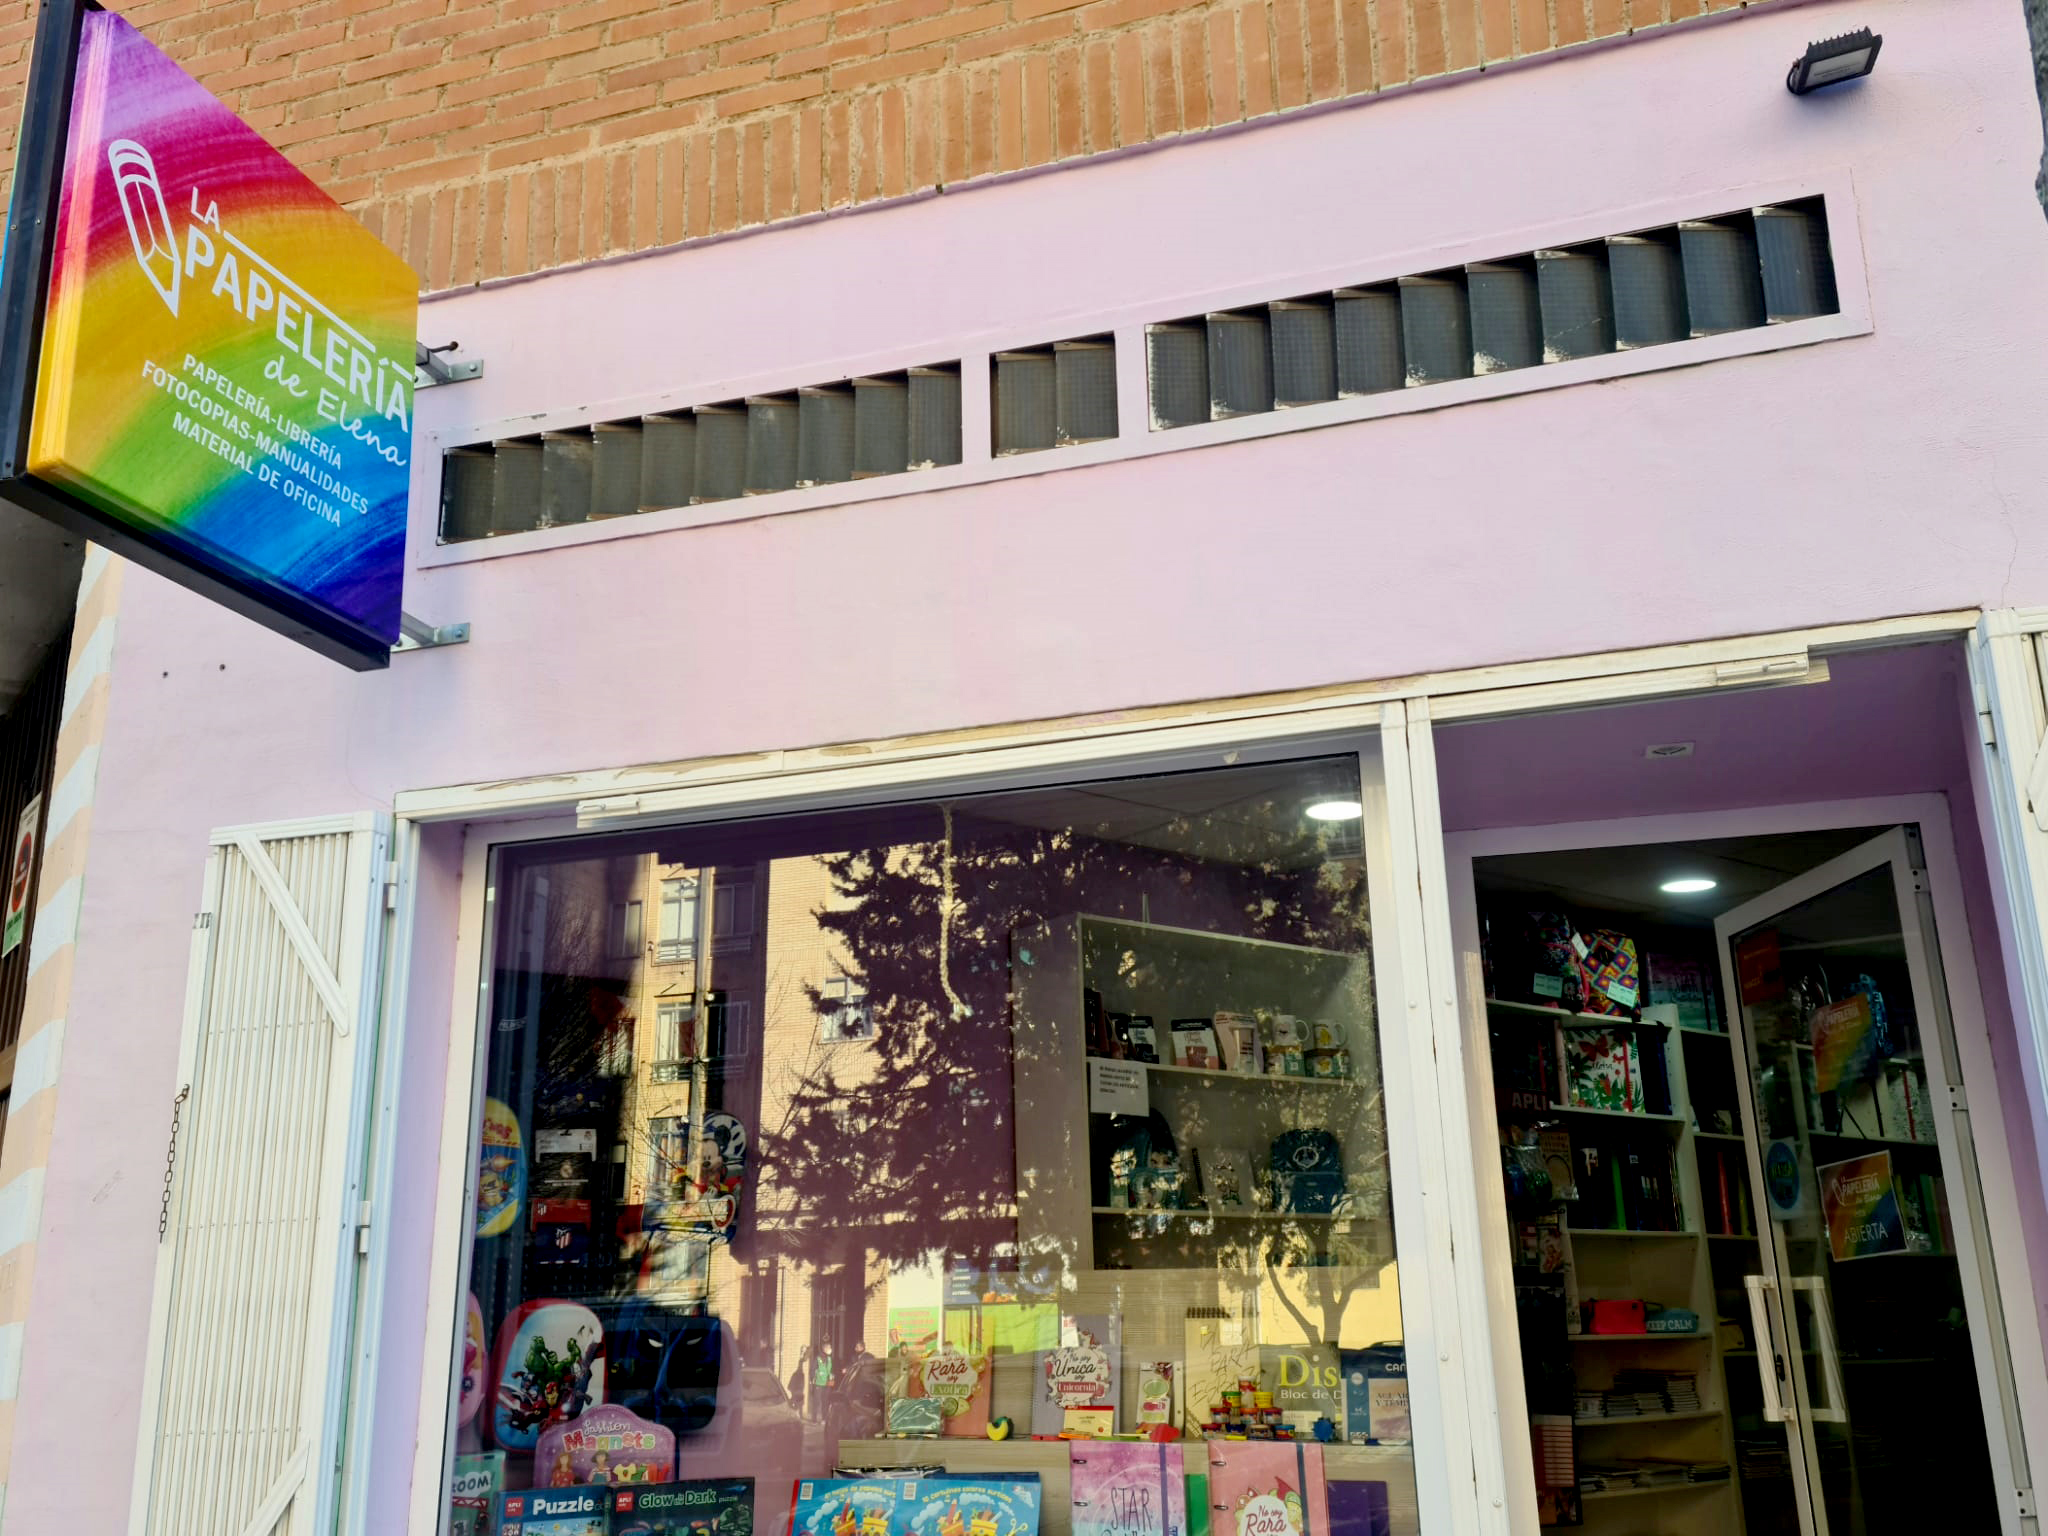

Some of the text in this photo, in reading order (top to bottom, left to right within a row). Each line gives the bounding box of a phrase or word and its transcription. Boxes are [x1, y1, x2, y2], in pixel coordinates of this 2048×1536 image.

[189, 186, 221, 234] LA
[185, 224, 409, 433] PAPELERÍA
[264, 356, 407, 467] de Elena
[142, 360, 369, 515] FOTOCOPIAS-MANUALIDADES
[172, 411, 342, 528] MATERIAL DE OFICINA
[1512, 1092, 1547, 1111] APLI
[1845, 1221, 1889, 1243] ABIERTA
[1667, 1319, 1693, 1330] CALM
[1278, 1354, 1341, 1388] Dis
[1280, 1389, 1308, 1399] Bloc
[1312, 1389, 1329, 1399] de
[562, 1429, 655, 1452] Magnets
[533, 1496, 595, 1516] Puzzle
[639, 1493, 675, 1508] Glow
[684, 1488, 717, 1505] Dark
[1111, 1487, 1152, 1532] STAR
[1246, 1513, 1287, 1536] Rara
